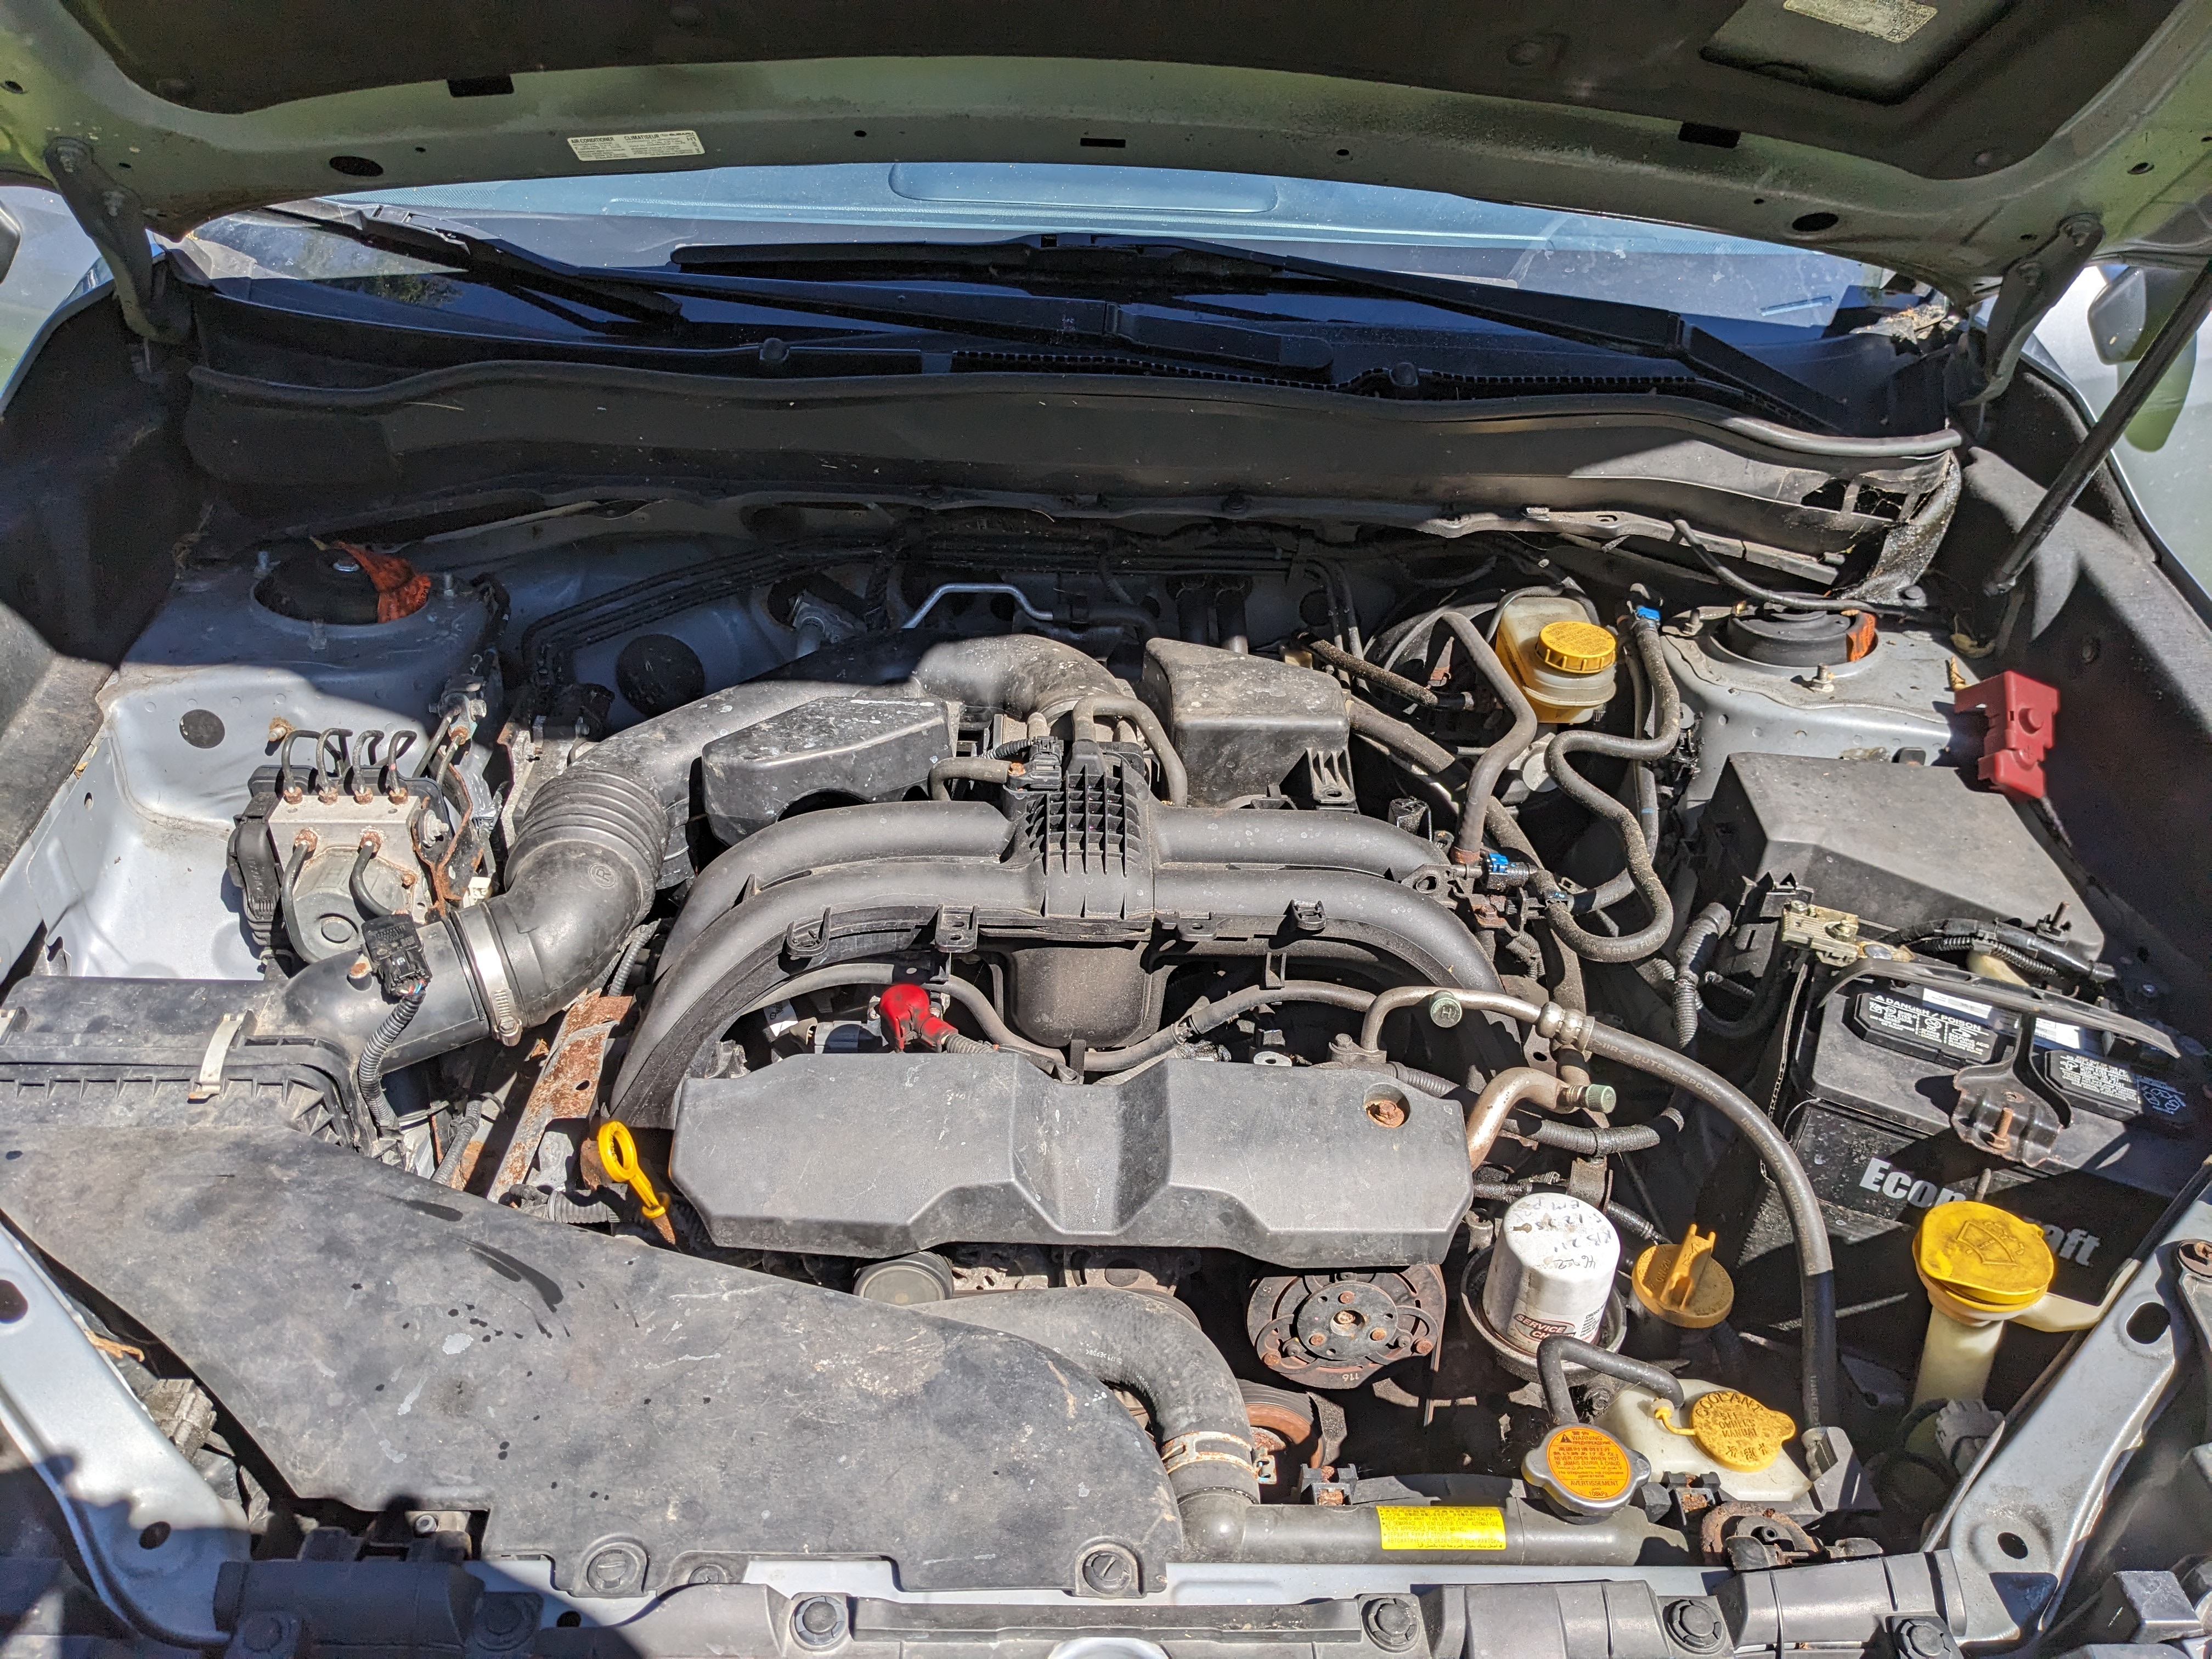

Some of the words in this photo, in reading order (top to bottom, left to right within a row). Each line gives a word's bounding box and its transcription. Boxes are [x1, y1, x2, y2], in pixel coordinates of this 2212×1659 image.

[1640, 935, 1658, 948] FUEL
[1884, 1013, 1912, 1024] EXPLOSIVE
[1886, 998, 1930, 1015] DANGER
[1941, 1014, 1981, 1031] POISON
[1898, 1010, 1917, 1019] SHIELD
[1949, 1032, 1975, 1044] SULFURIC
[1633, 1053, 1720, 1101] OUTER>EPDM<
[1516, 1314, 1566, 1333] SERVICE
[1695, 1392, 1764, 1417] COOLANT
[1720, 1412, 1738, 1420] SEE
[1722, 1428, 1758, 1438] MANUAL
